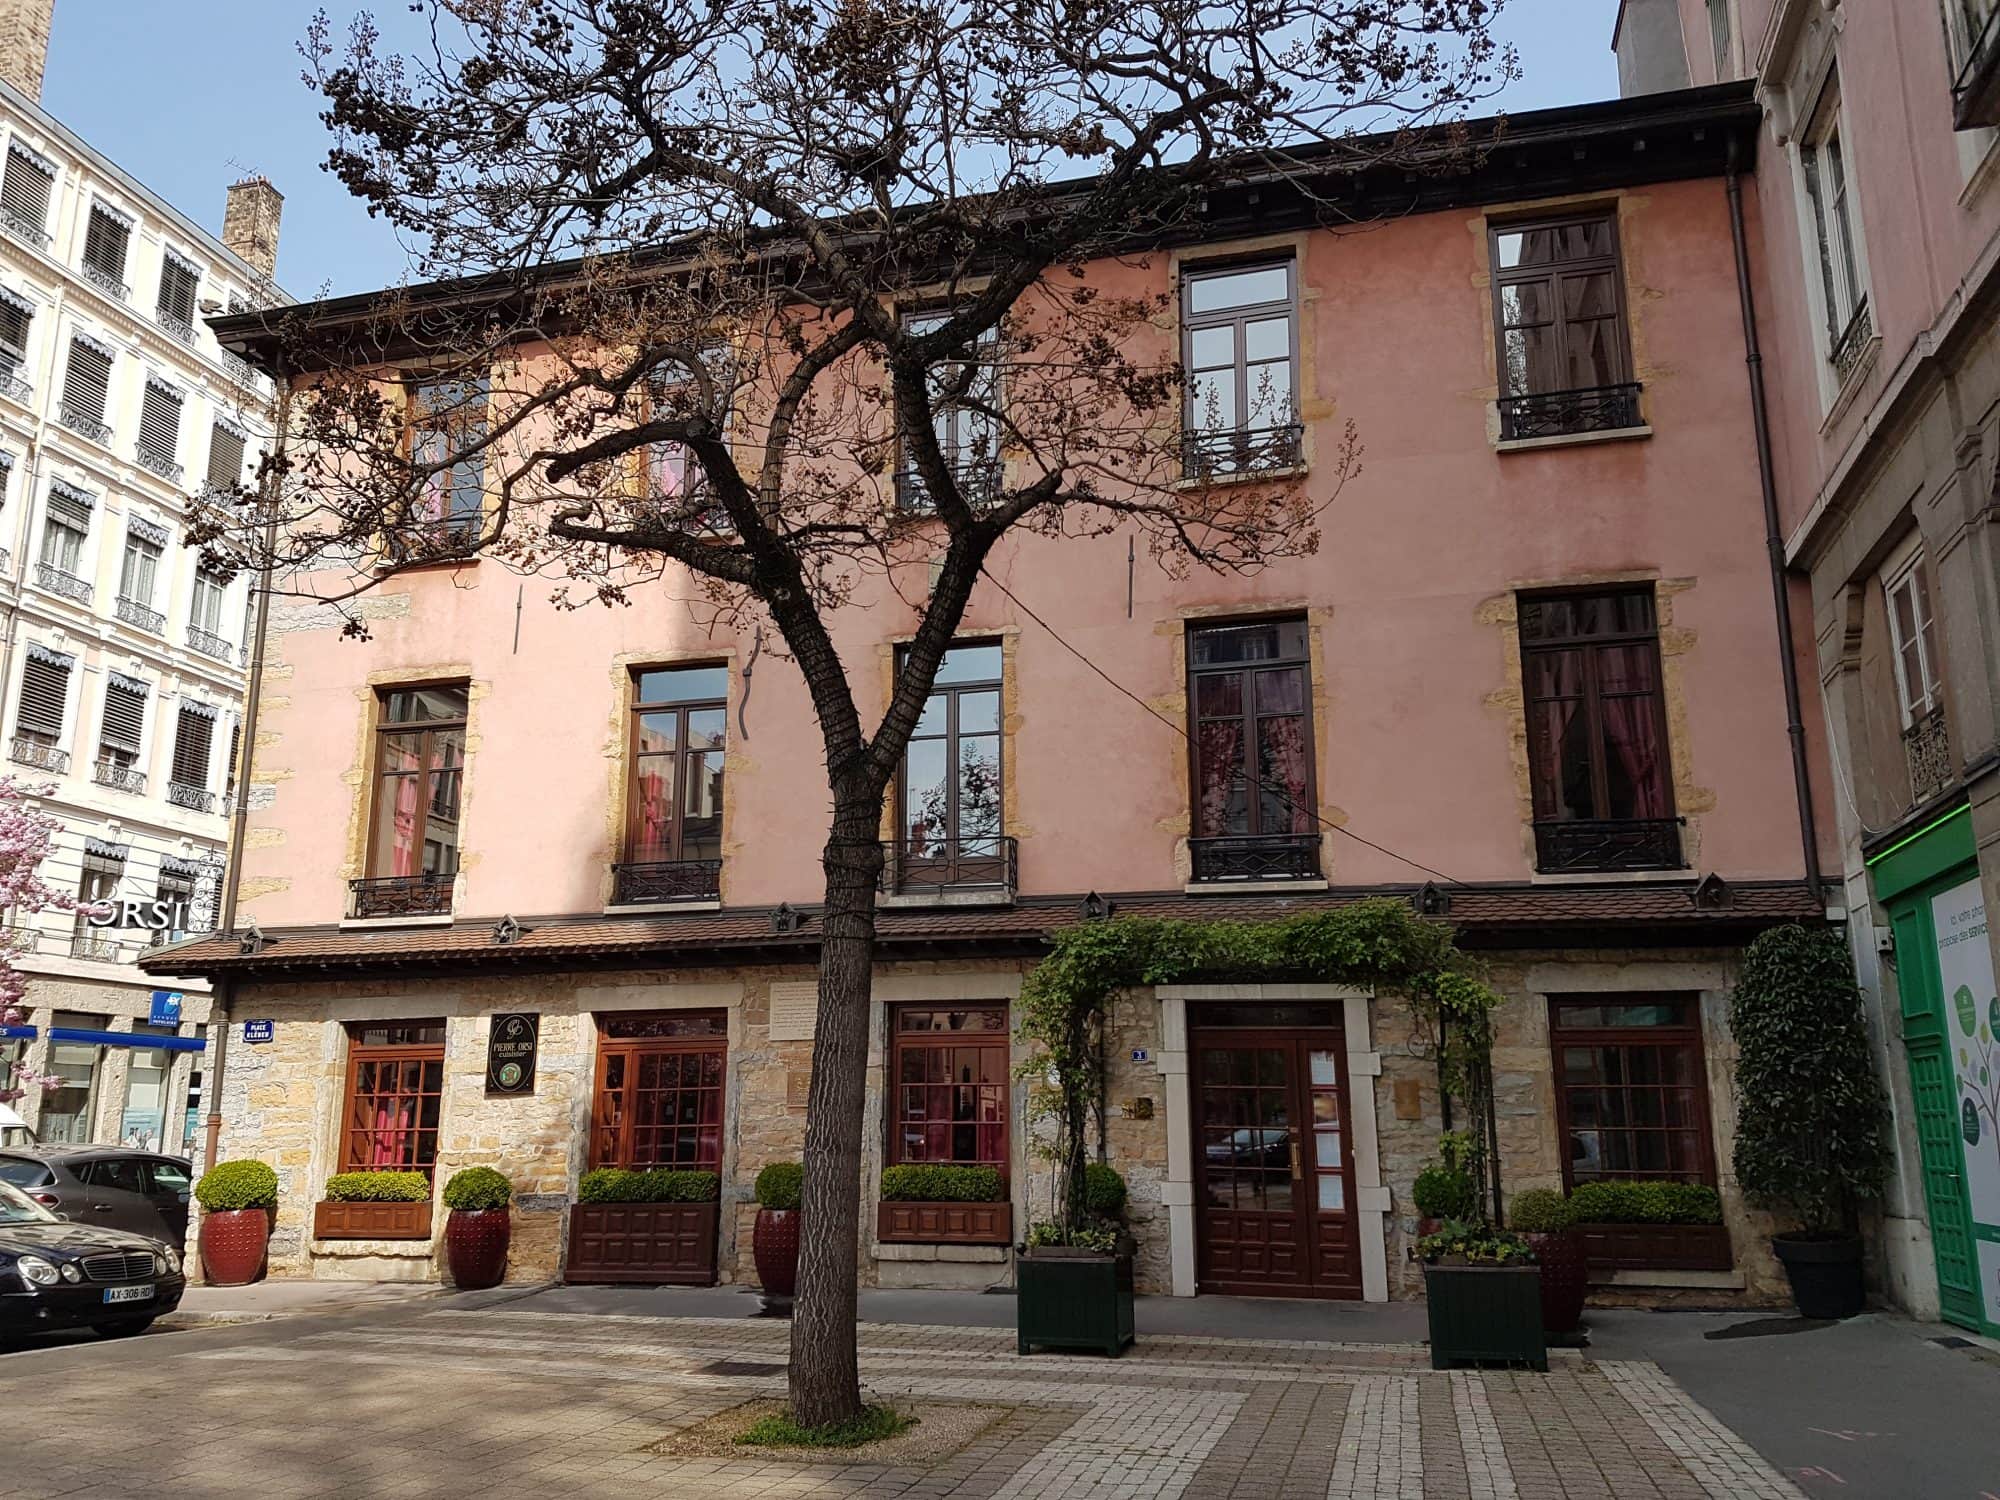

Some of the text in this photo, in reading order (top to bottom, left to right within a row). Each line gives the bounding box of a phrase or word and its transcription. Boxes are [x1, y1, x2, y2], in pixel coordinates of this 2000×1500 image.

[89, 900, 184, 930] ORSI
[494, 1041, 533, 1052] PIERRE ORSI
[499, 1050, 527, 1058] cuisinier
